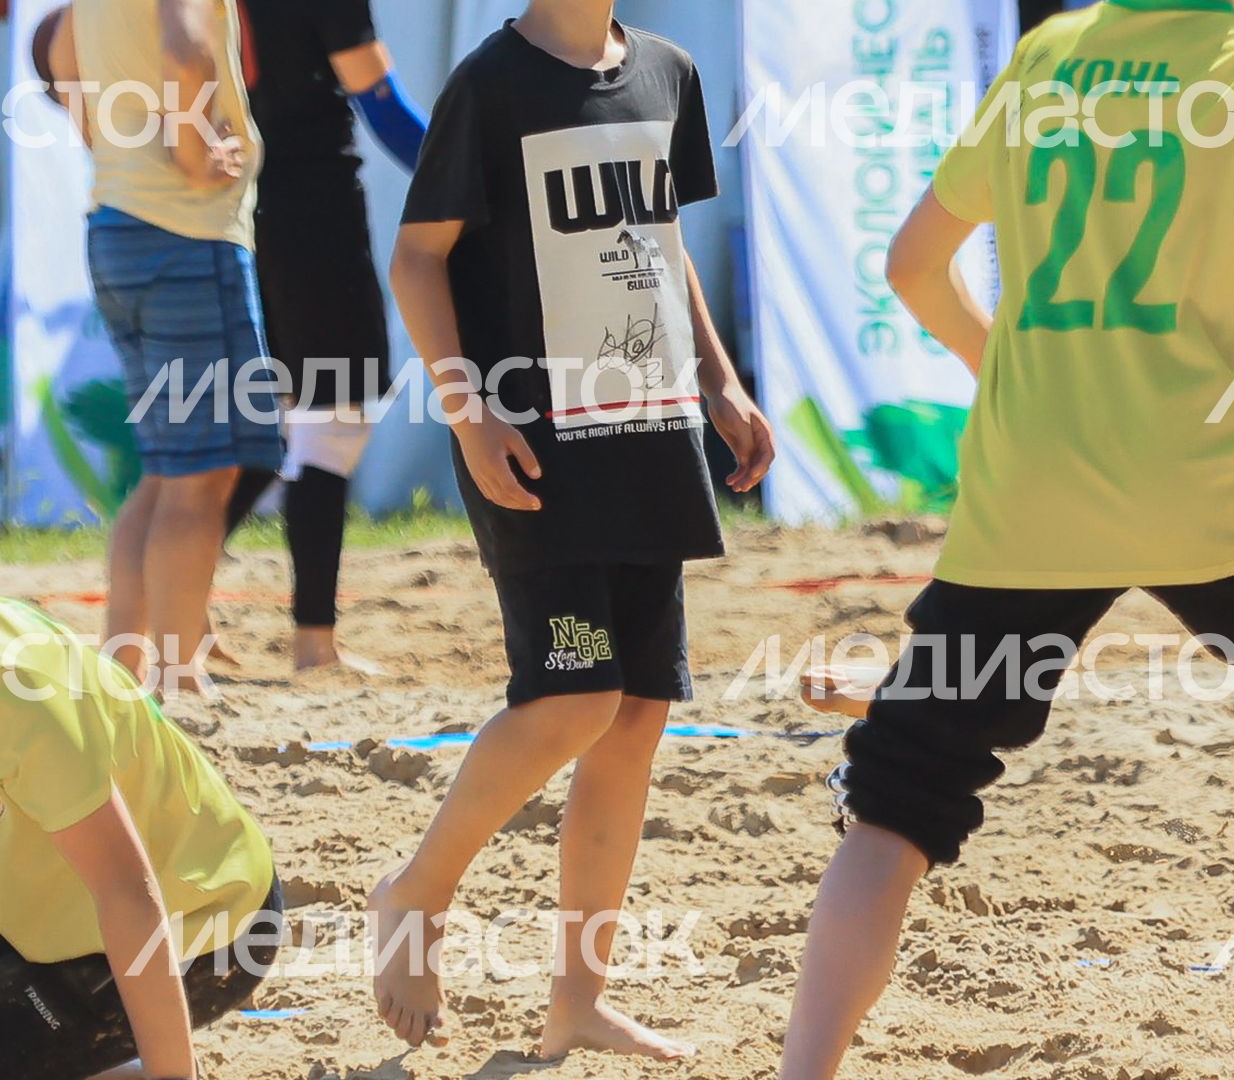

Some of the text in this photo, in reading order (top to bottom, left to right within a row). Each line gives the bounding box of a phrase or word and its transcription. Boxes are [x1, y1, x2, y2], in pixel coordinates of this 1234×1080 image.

[1050, 58, 1180, 98] КОНЬ
[1016, 127, 1186, 335] 22
[600, 249, 630, 263] WILD
[556, 429, 588, 442] YOU'RE
[588, 426, 614, 438] RIGHT
[615, 424, 623, 435] IF
[624, 420, 666, 434] ALWAYS
